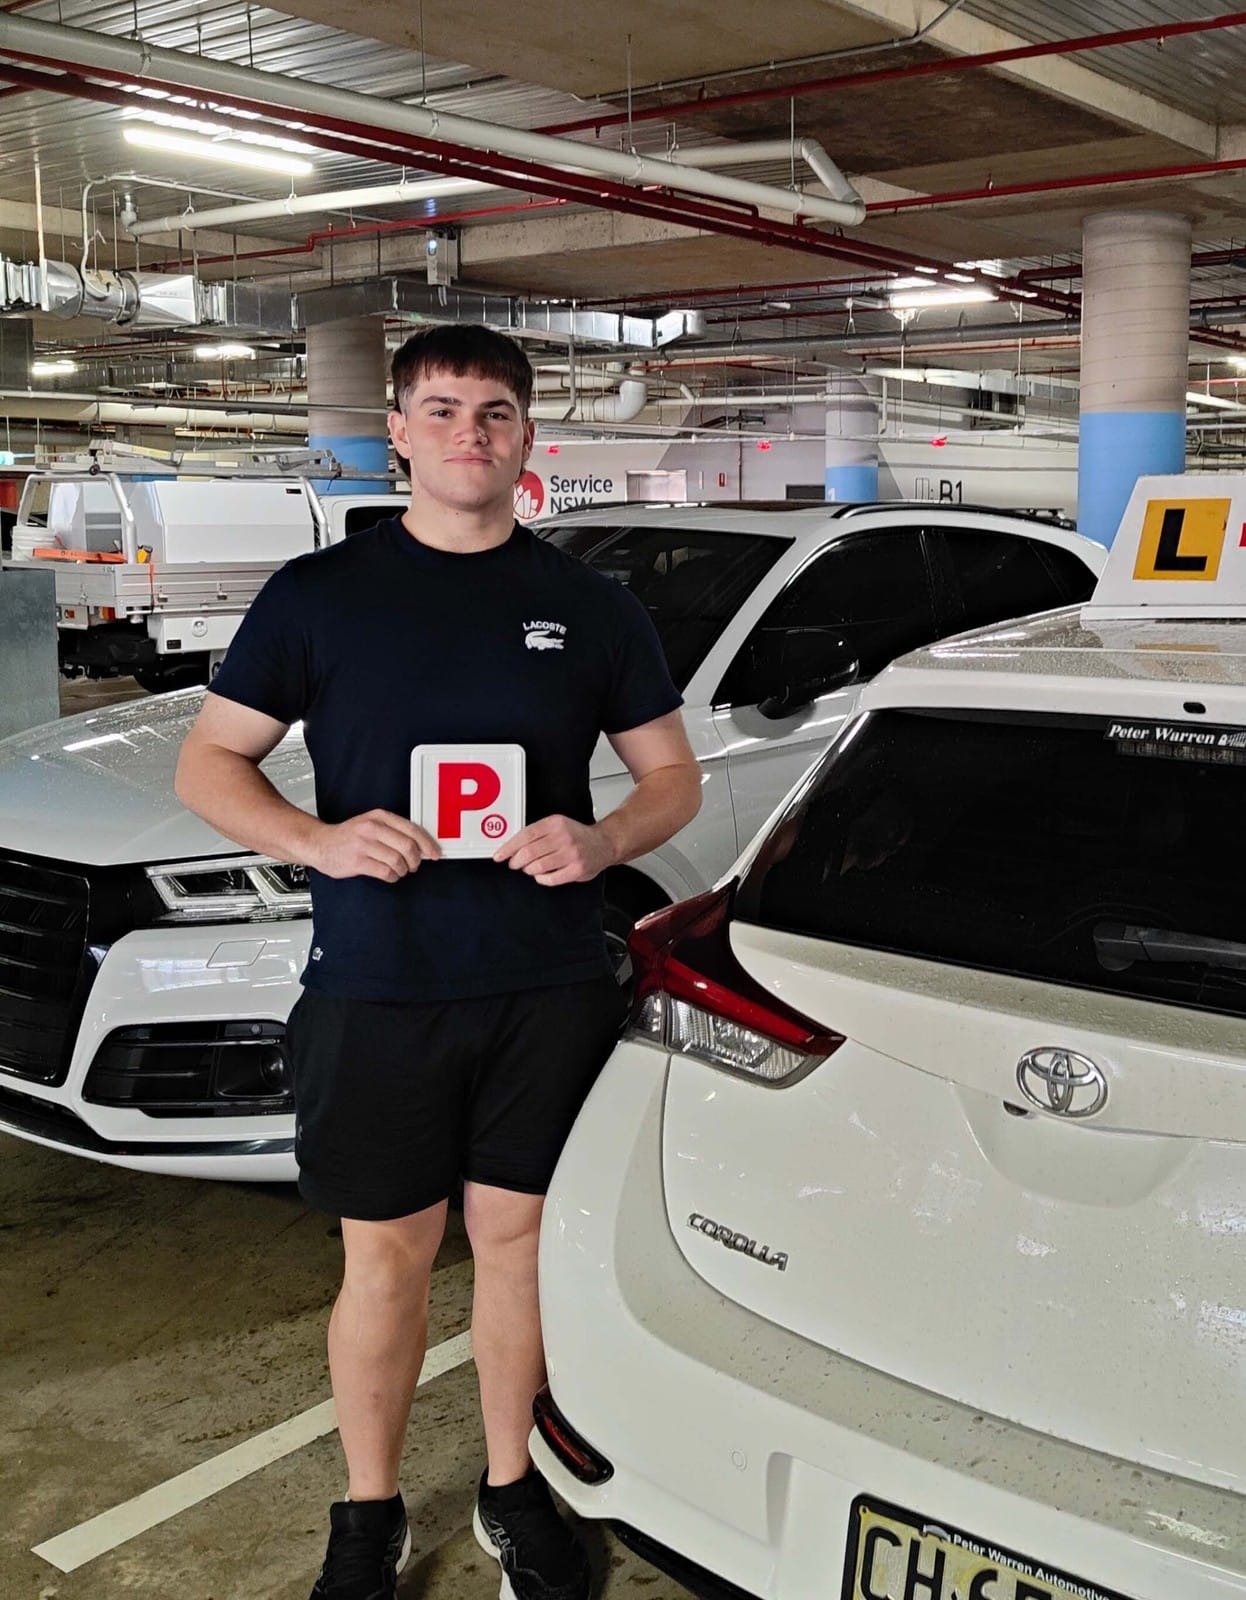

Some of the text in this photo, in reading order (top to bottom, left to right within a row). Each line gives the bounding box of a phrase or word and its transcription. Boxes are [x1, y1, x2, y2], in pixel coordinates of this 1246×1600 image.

[550, 474, 613, 493] Service
[940, 480, 962, 503] B1
[1153, 508, 1208, 571] L
[522, 620, 567, 635] LACOSTE
[1108, 724, 1149, 739] Peter
[1155, 727, 1215, 745] Warren
[438, 763, 501, 838] P
[487, 821, 502, 831] 90
[688, 1213, 788, 1271] COROLLA
[953, 1534, 985, 1556] Peter
[988, 1547, 1033, 1575] Warren
